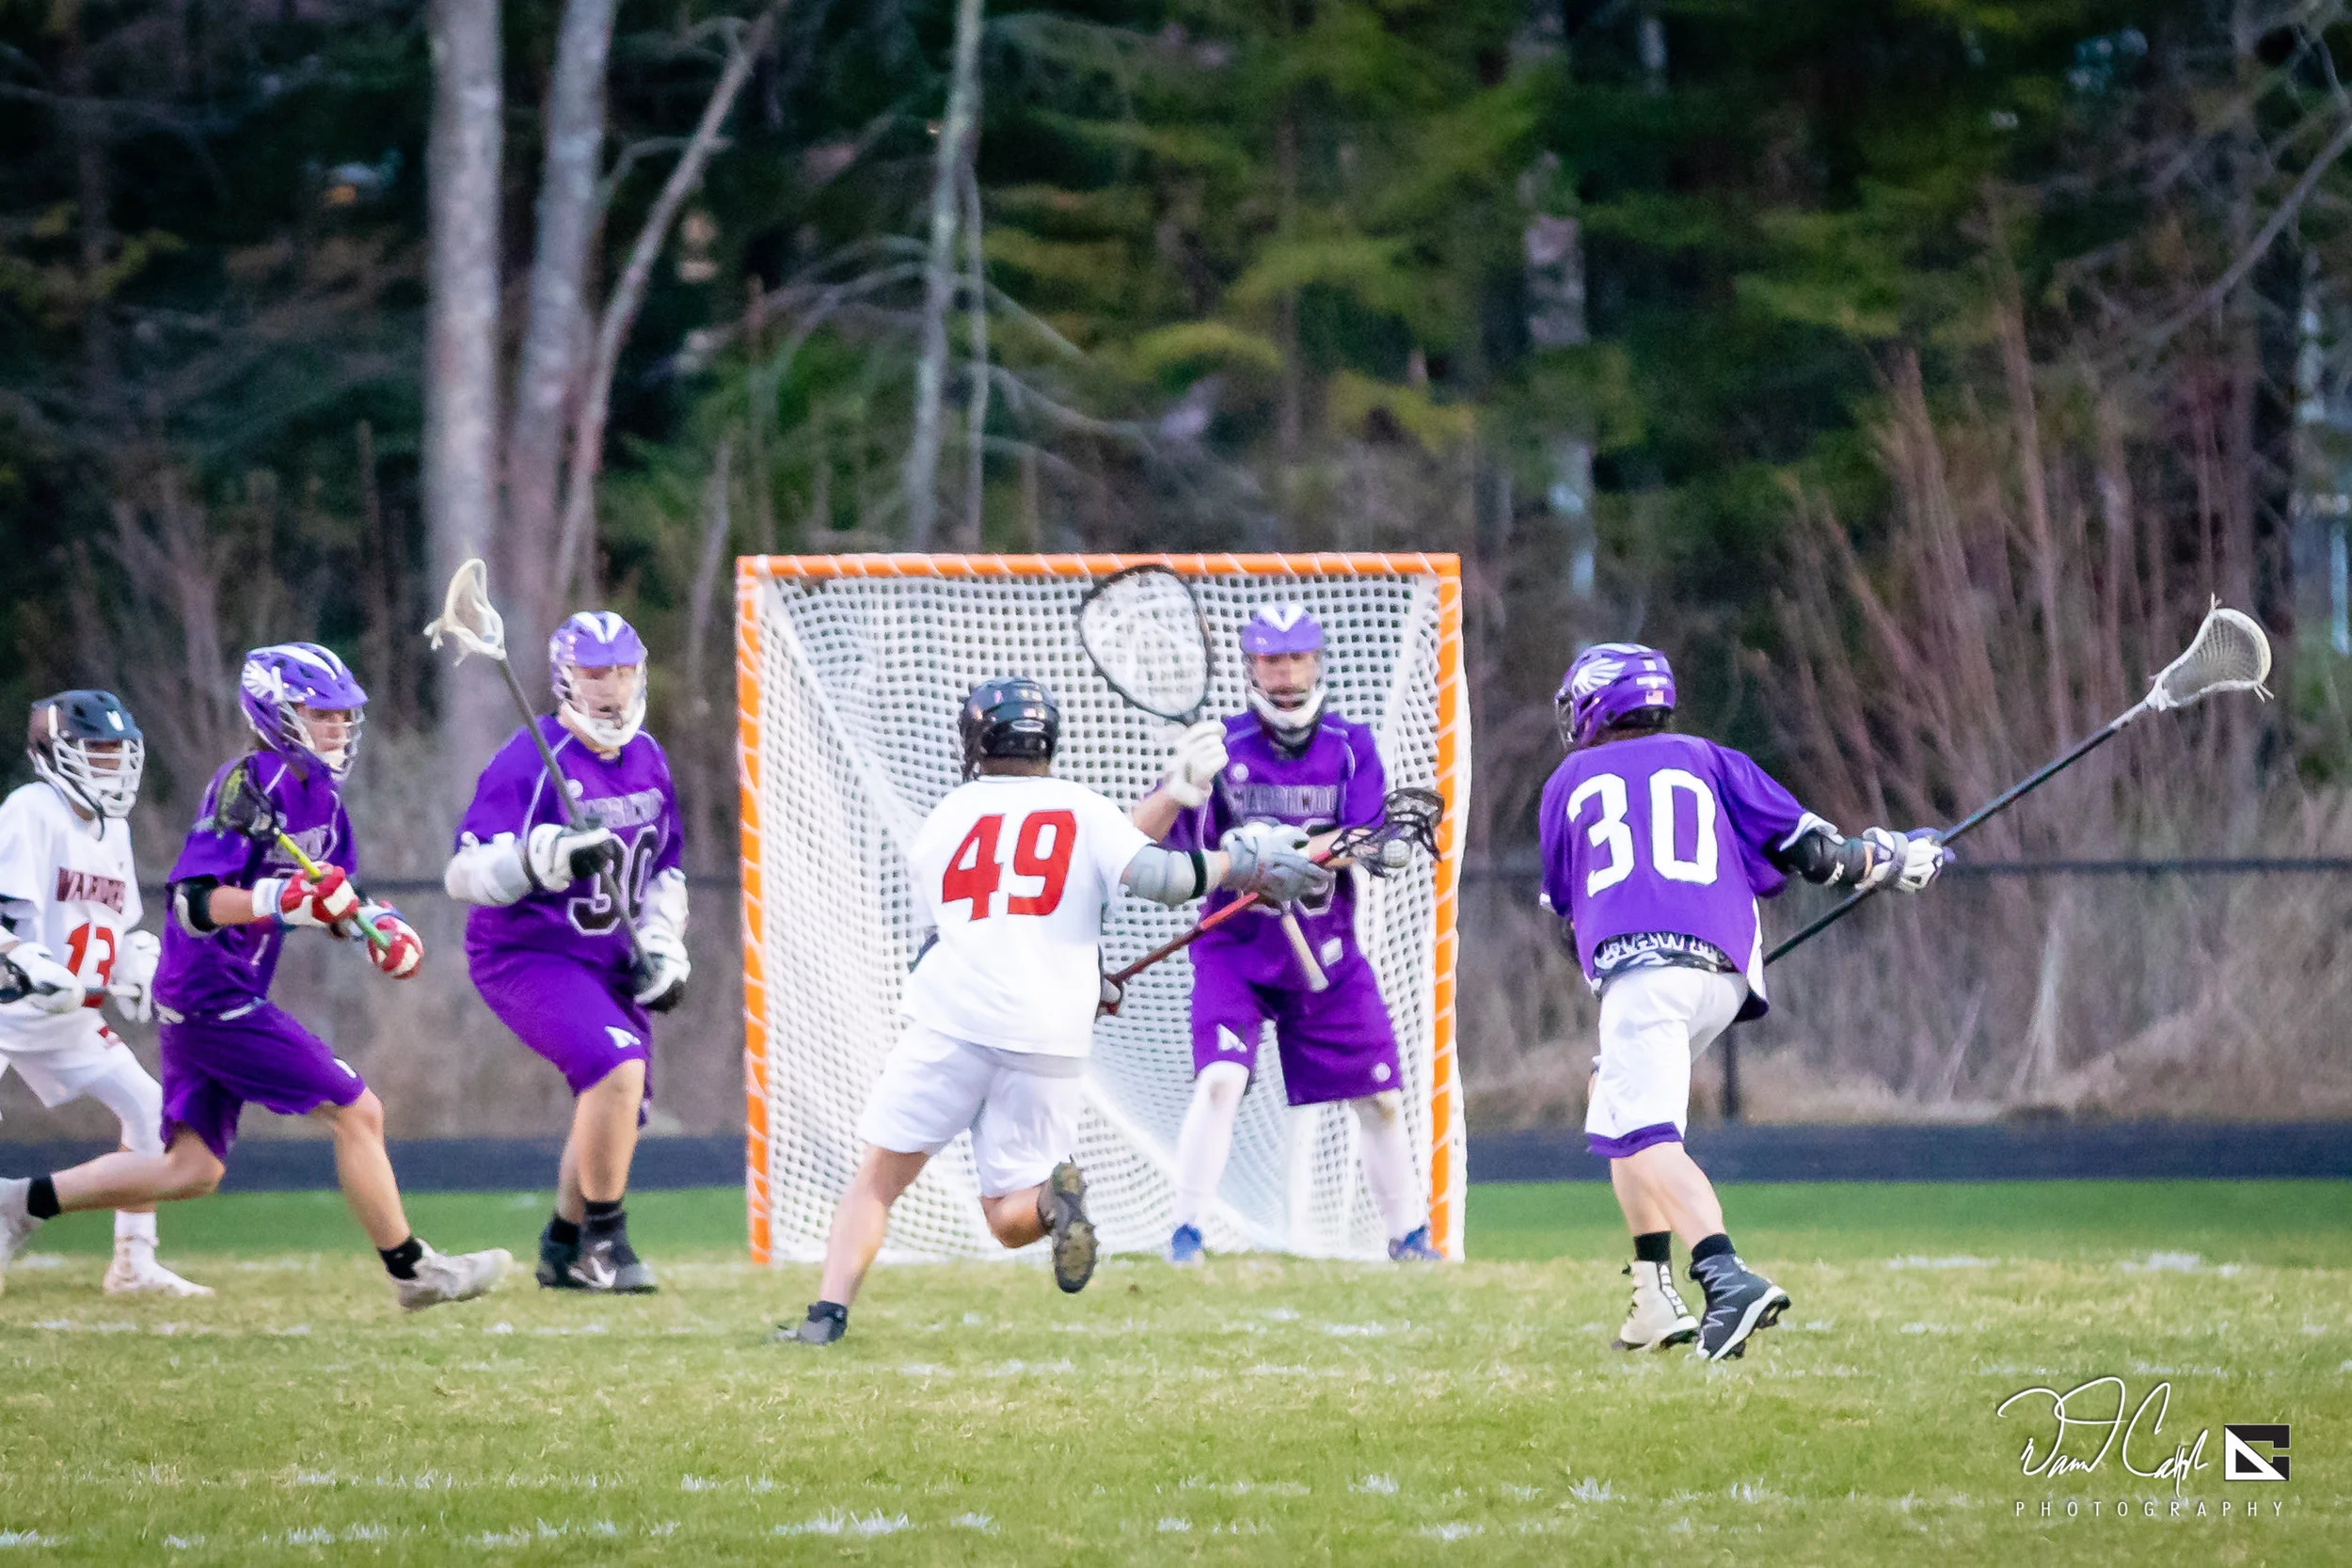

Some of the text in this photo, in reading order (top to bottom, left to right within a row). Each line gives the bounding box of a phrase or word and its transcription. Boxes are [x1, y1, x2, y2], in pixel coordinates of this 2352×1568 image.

[942, 808, 1077, 922] 49
[1566, 768, 1718, 897] 30
[65, 921, 116, 988] 13
